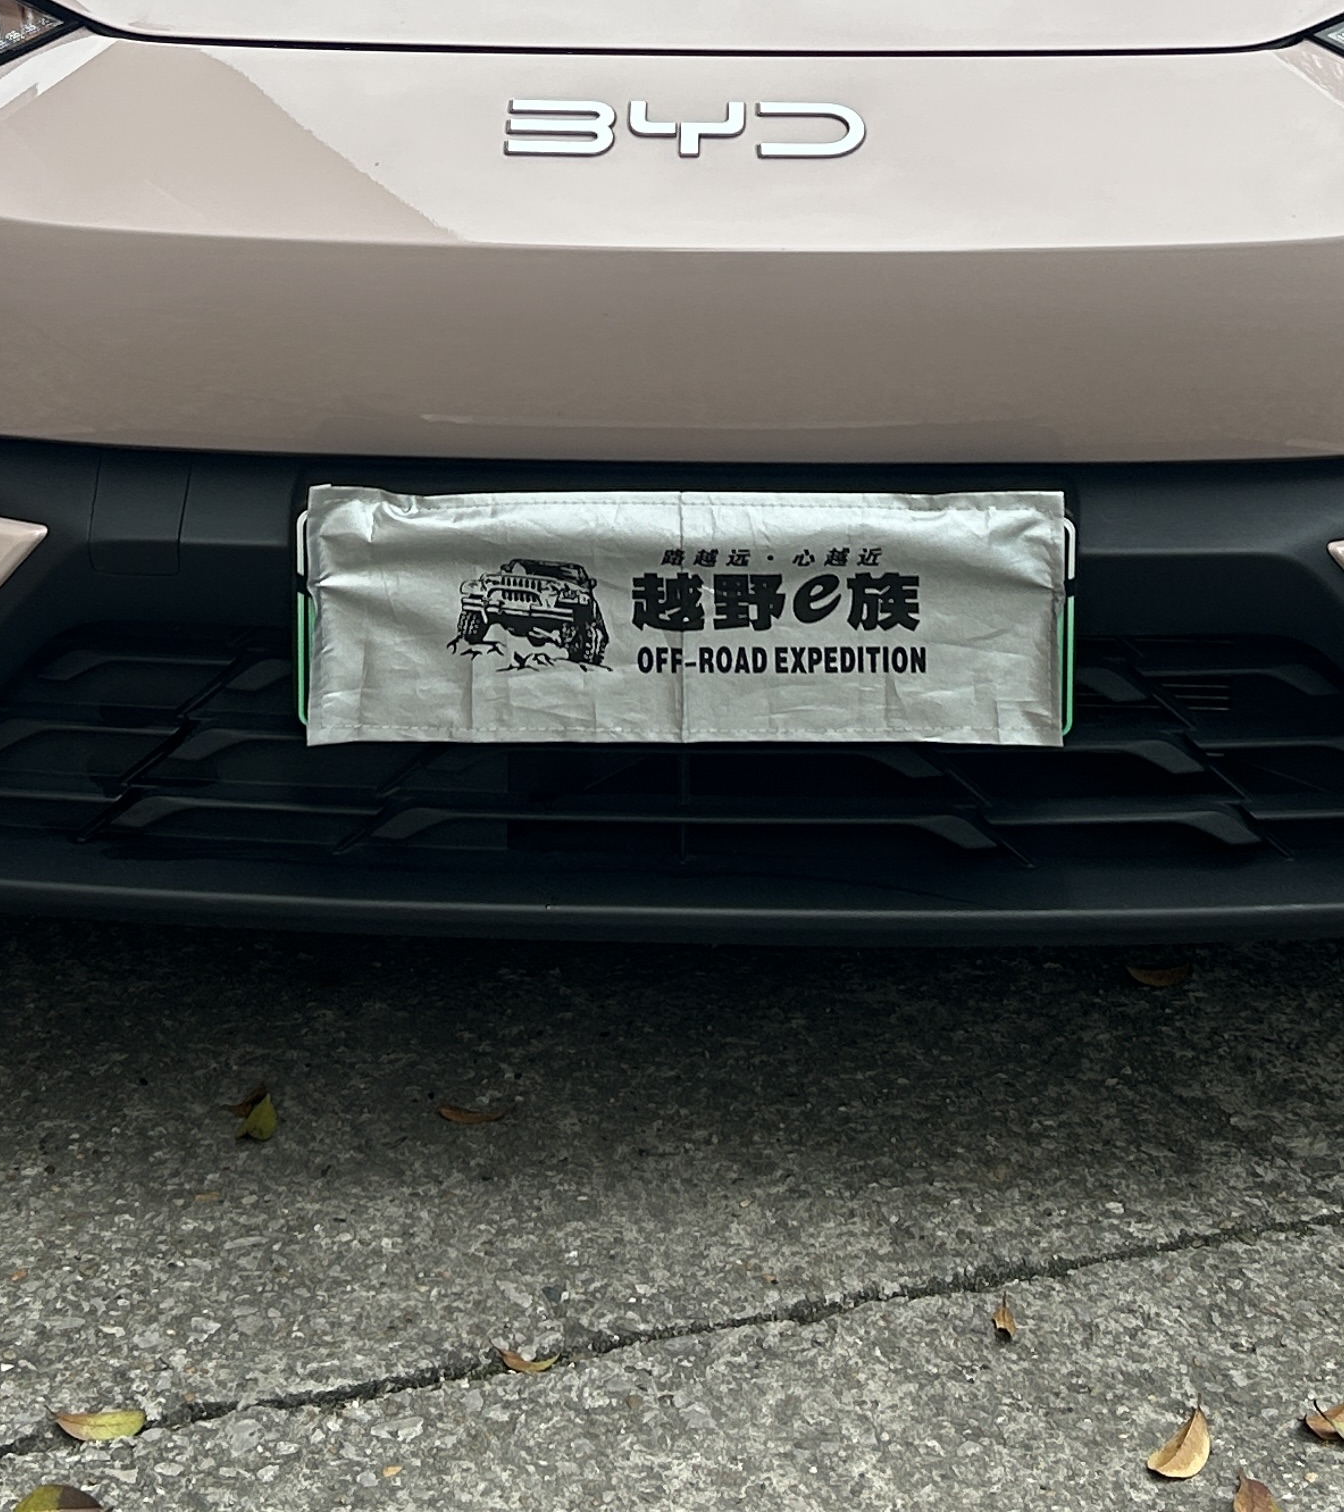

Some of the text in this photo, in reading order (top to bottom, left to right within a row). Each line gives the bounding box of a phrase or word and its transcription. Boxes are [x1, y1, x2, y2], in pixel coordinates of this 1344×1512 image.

[504, 98, 866, 158] BYD
[632, 572, 920, 631] 越野e族
[637, 646, 927, 674] OFF-ROAD EXPEDITION
